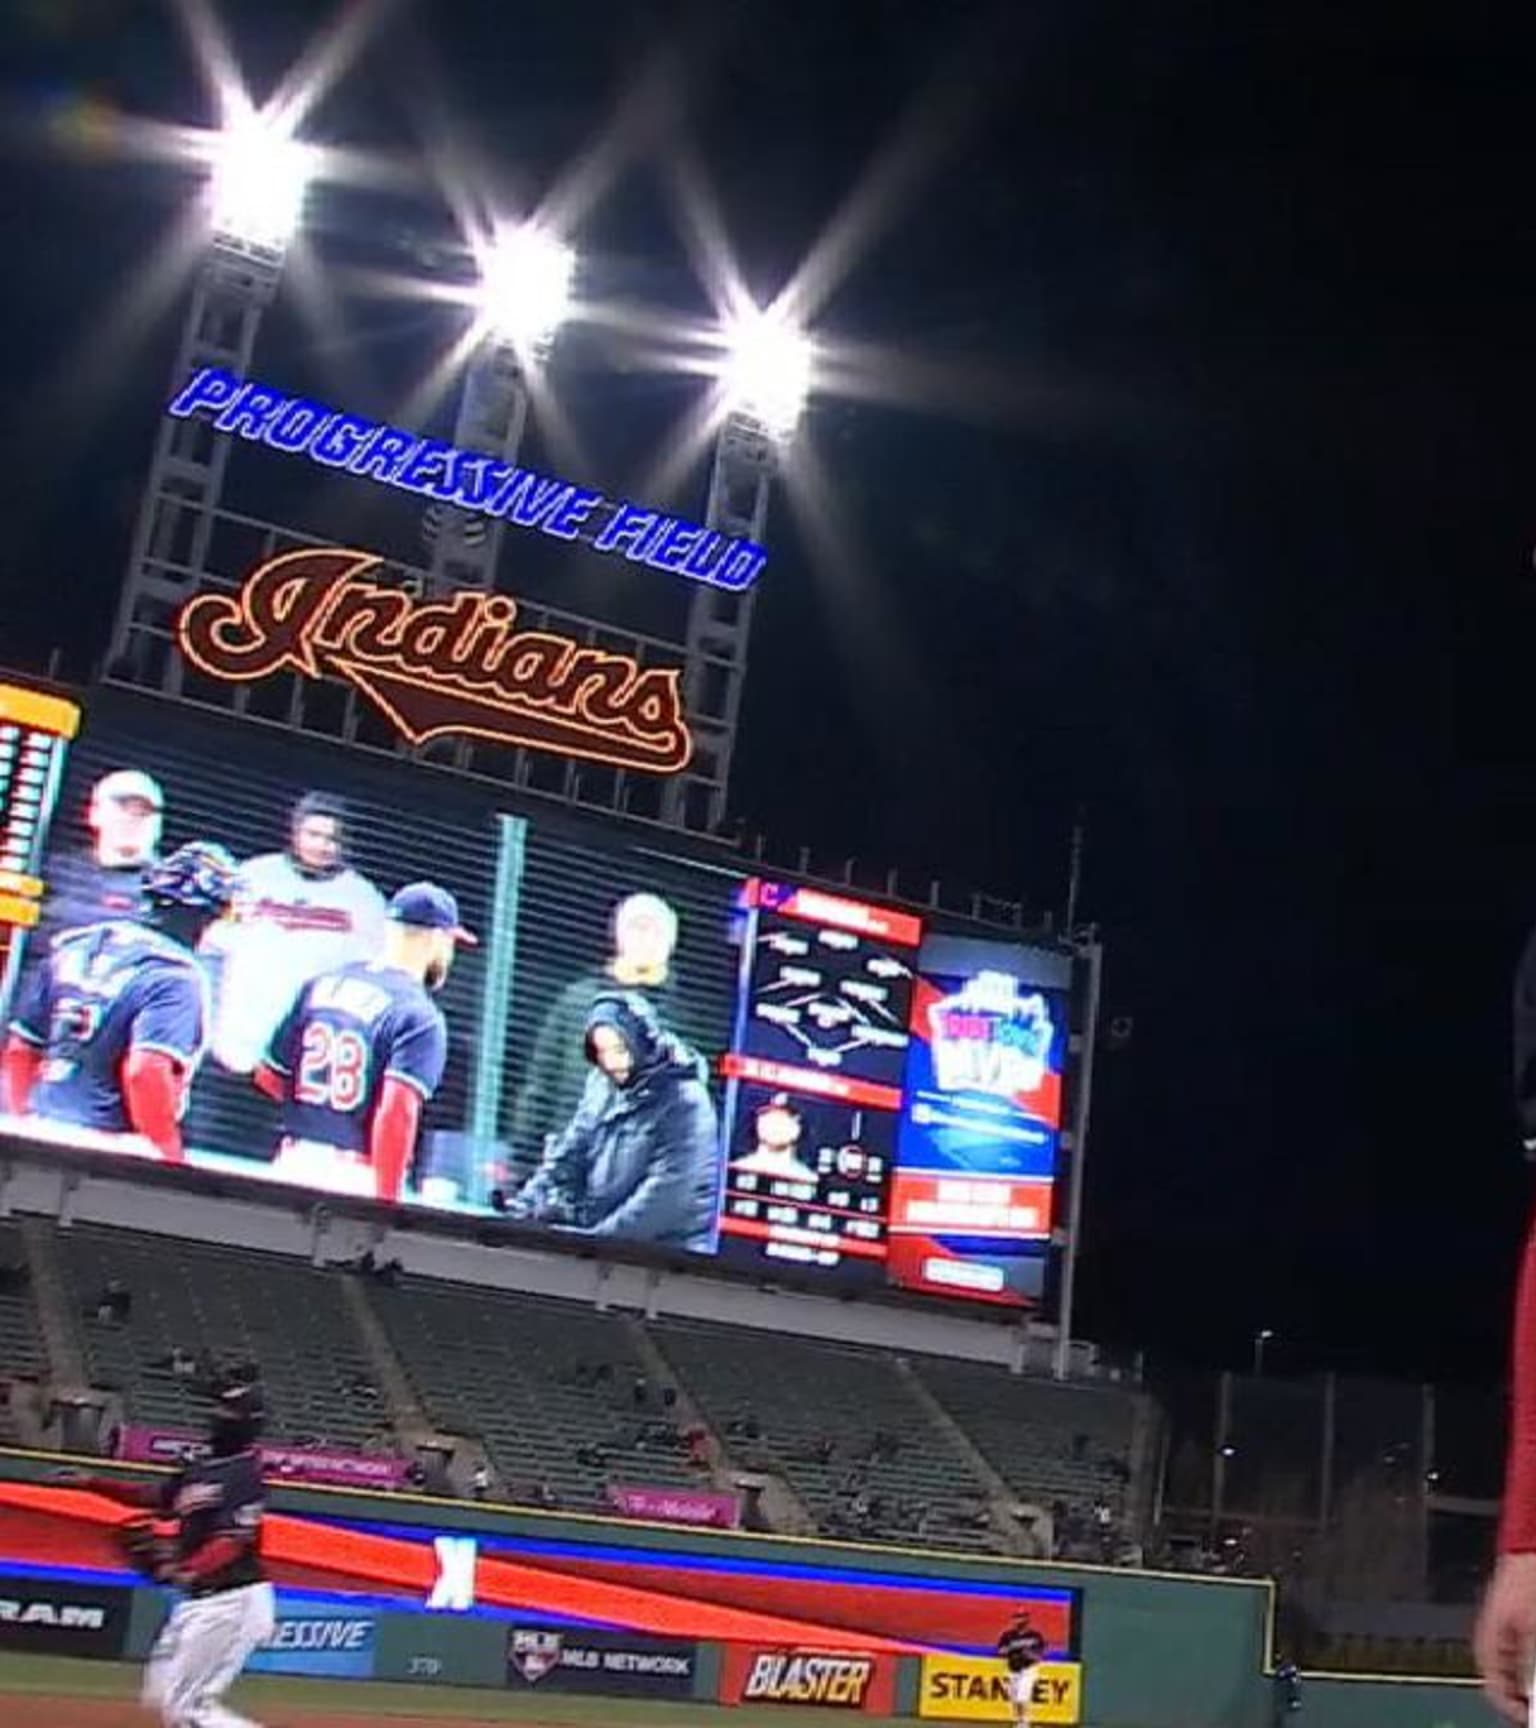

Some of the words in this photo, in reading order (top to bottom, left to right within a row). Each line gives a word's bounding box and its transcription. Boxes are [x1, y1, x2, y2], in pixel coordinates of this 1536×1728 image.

[168, 367, 604, 541] PROGRESSIVE
[594, 504, 768, 592] FIELD
[180, 549, 691, 773] Indians
[295, 1020, 366, 1111] 28
[603, 1652, 690, 1676] NETWORK
[744, 1654, 871, 1704] BLASTER
[929, 1671, 1070, 1704] STANEY
